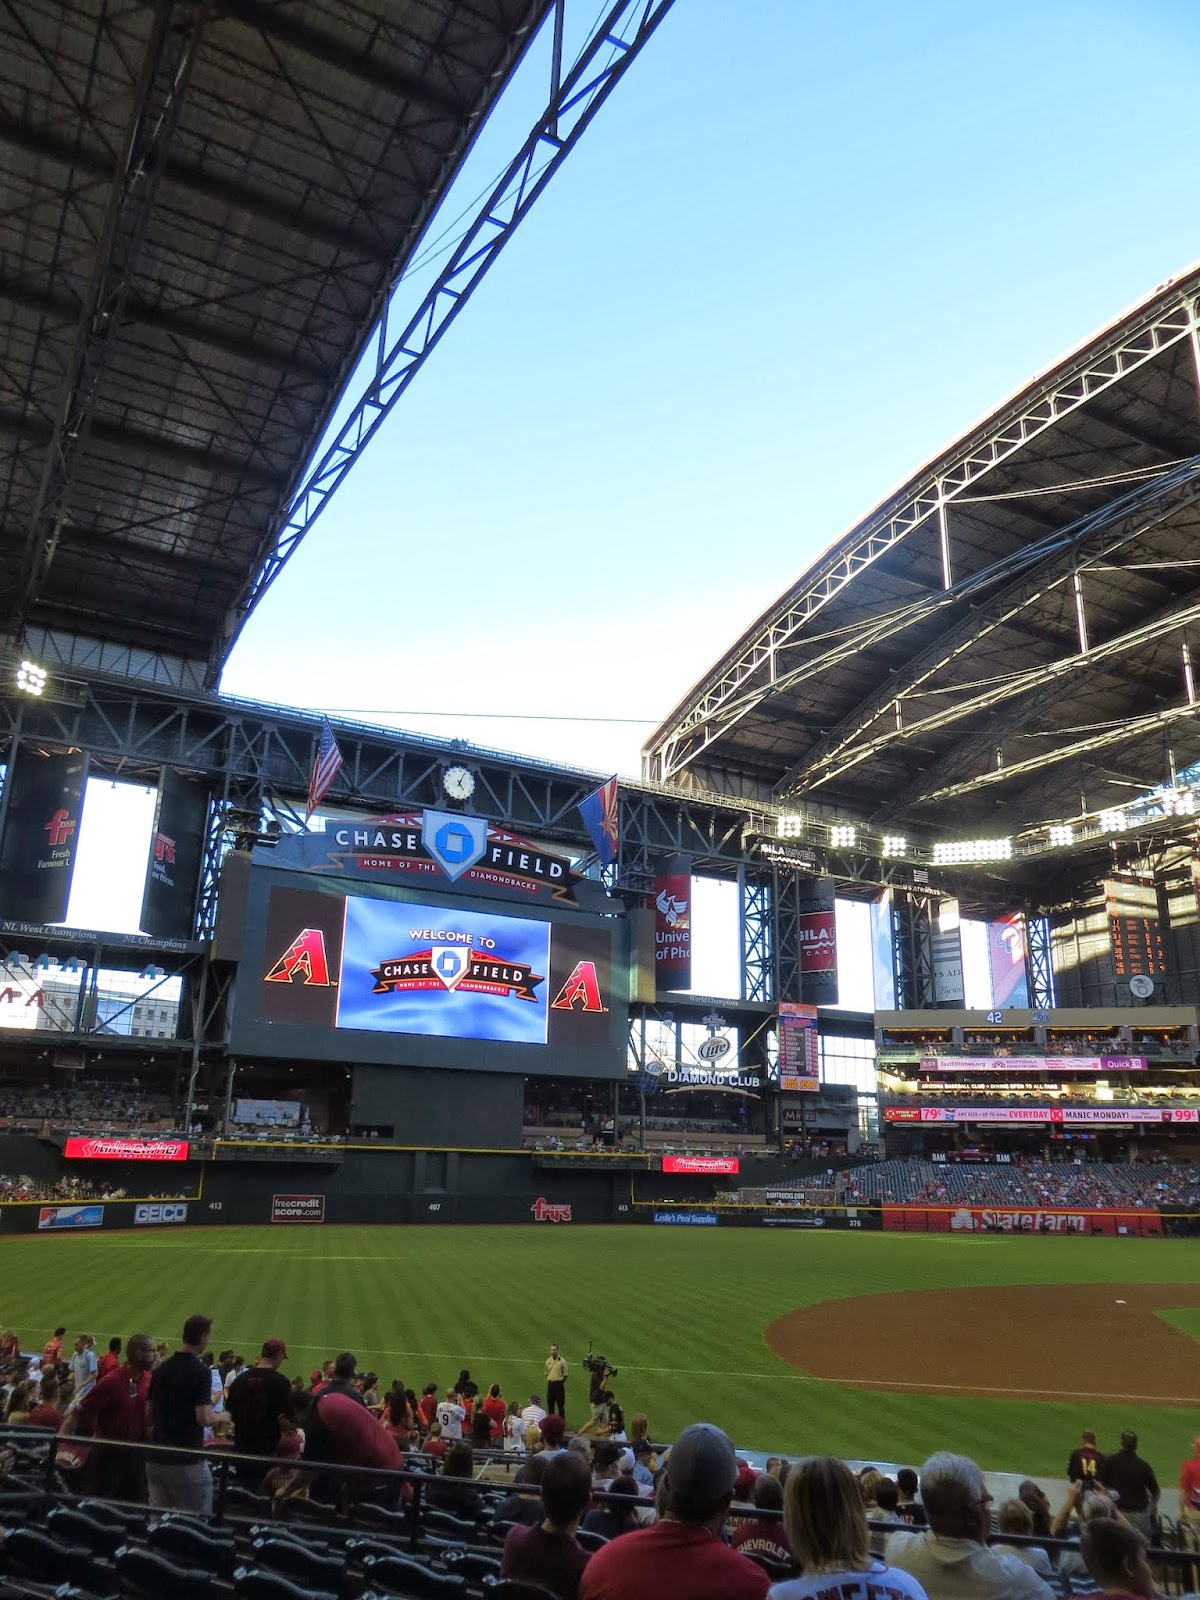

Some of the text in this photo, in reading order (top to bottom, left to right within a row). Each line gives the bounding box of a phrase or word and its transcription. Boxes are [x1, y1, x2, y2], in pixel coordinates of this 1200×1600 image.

[52, 849, 70, 858] Fresh
[335, 830, 563, 878] CHASE FIELD
[761, 844, 785, 856] GILA
[38, 860, 64, 868] Famous
[363, 859, 392, 868] HOME
[418, 864, 436, 872] THE
[470, 871, 536, 890] DIAMONDBACKS
[3, 922, 97, 940] NL West Champions
[656, 930, 690, 944] Unive
[123, 935, 187, 950] NL Champions
[409, 929, 496, 949] WELCOME TO
[656, 948, 668, 960] of
[384, 964, 523, 981] CHASE FIELD
[460, 983, 505, 993] DIAMONDBACKS
[708, 999, 739, 1007] Champions
[987, 1011, 1002, 1023] 42
[1031, 1011, 1050, 1024] 20
[1107, 1059, 1141, 1069] QuickER
[668, 1071, 760, 1087] DIAMOND CLUB
[1009, 1110, 1048, 1118] EVERYDAY
[1066, 1110, 1130, 1119] MANIC MONDAY!
[932, 1153, 946, 1162] RAM
[996, 1154, 1010, 1163] RAM
[275, 1198, 319, 1208] freecredit
[138, 1205, 186, 1221] GEICO
[275, 1208, 321, 1216] score.com
[531, 1198, 571, 1222] fry's
[655, 1214, 716, 1224] Leslie's Pool Supplies
[981, 1209, 1085, 1231] State Farm
[442, 1413, 449, 1426] 9
[1081, 1458, 1097, 1476] 14
